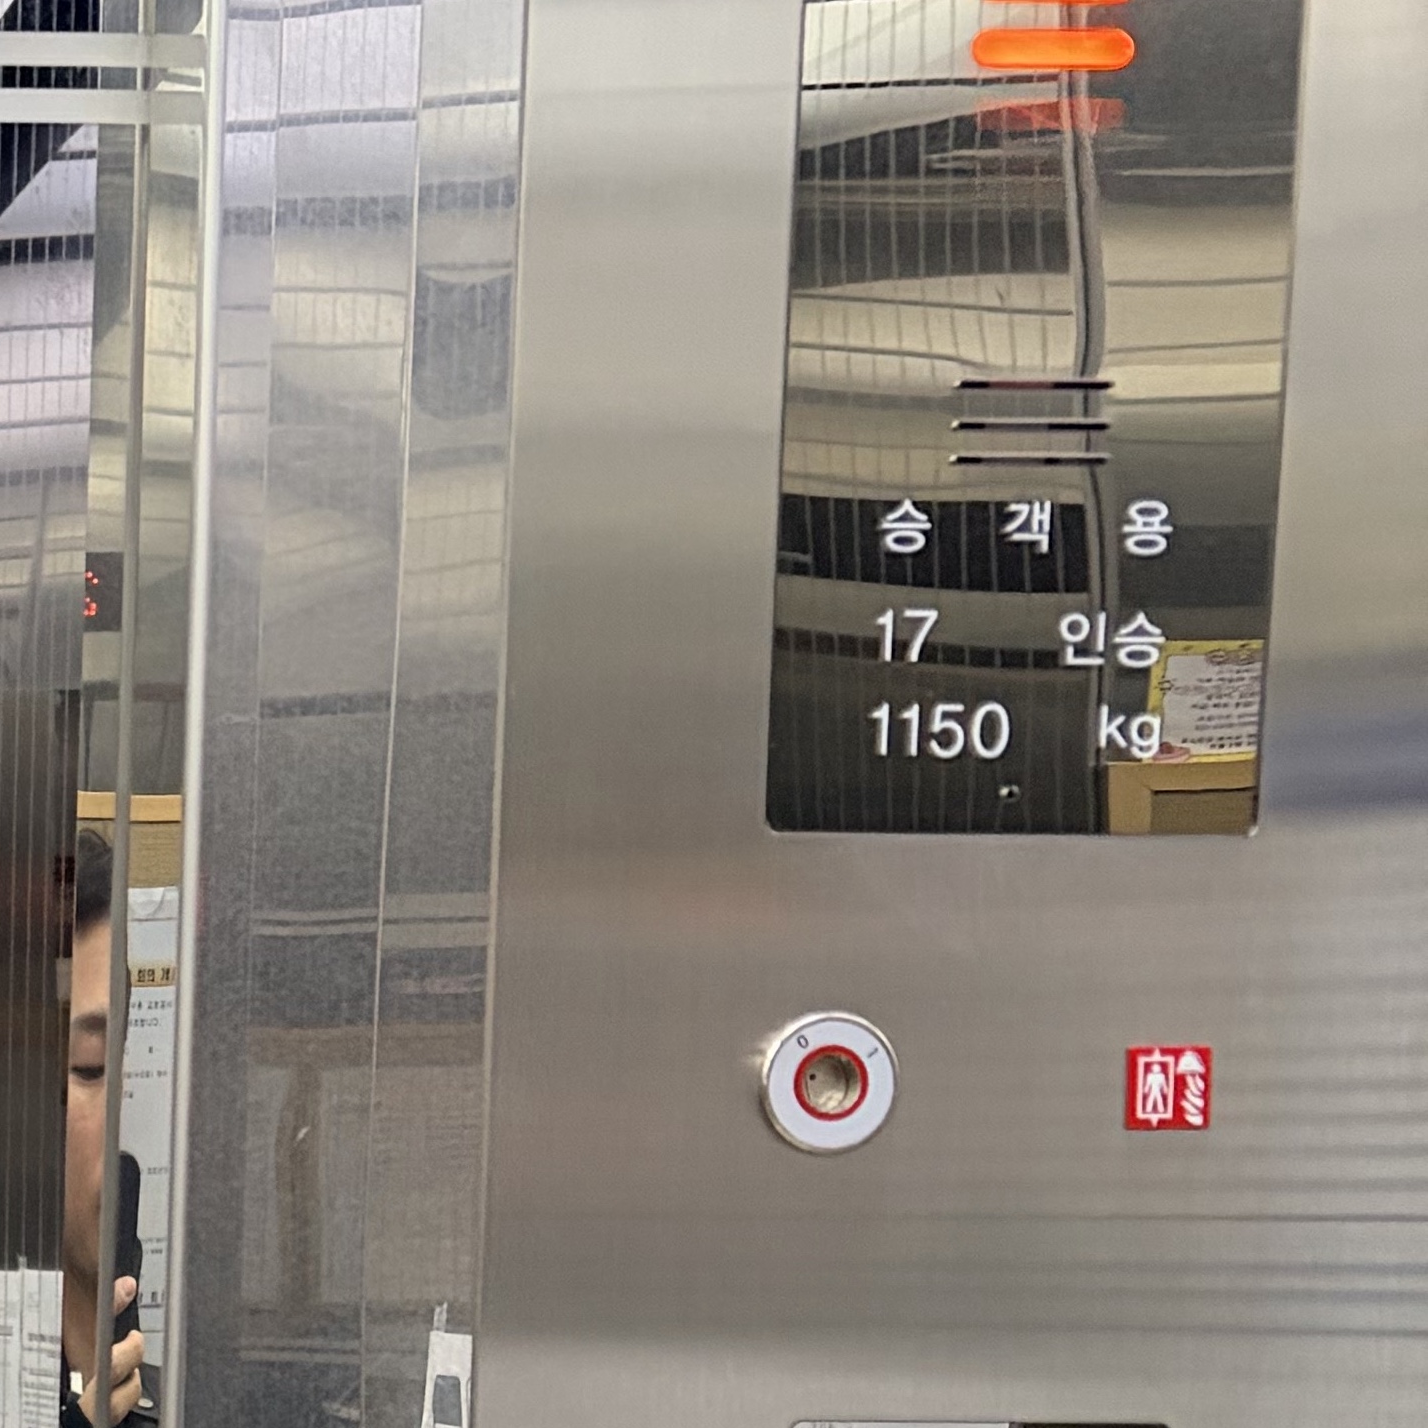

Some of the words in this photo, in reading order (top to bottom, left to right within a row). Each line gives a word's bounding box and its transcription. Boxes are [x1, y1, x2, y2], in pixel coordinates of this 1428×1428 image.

[874, 608, 939, 663] 17
[1058, 611, 1167, 668] 인승
[868, 702, 1011, 760] 1150
[1099, 704, 1163, 760] kg
